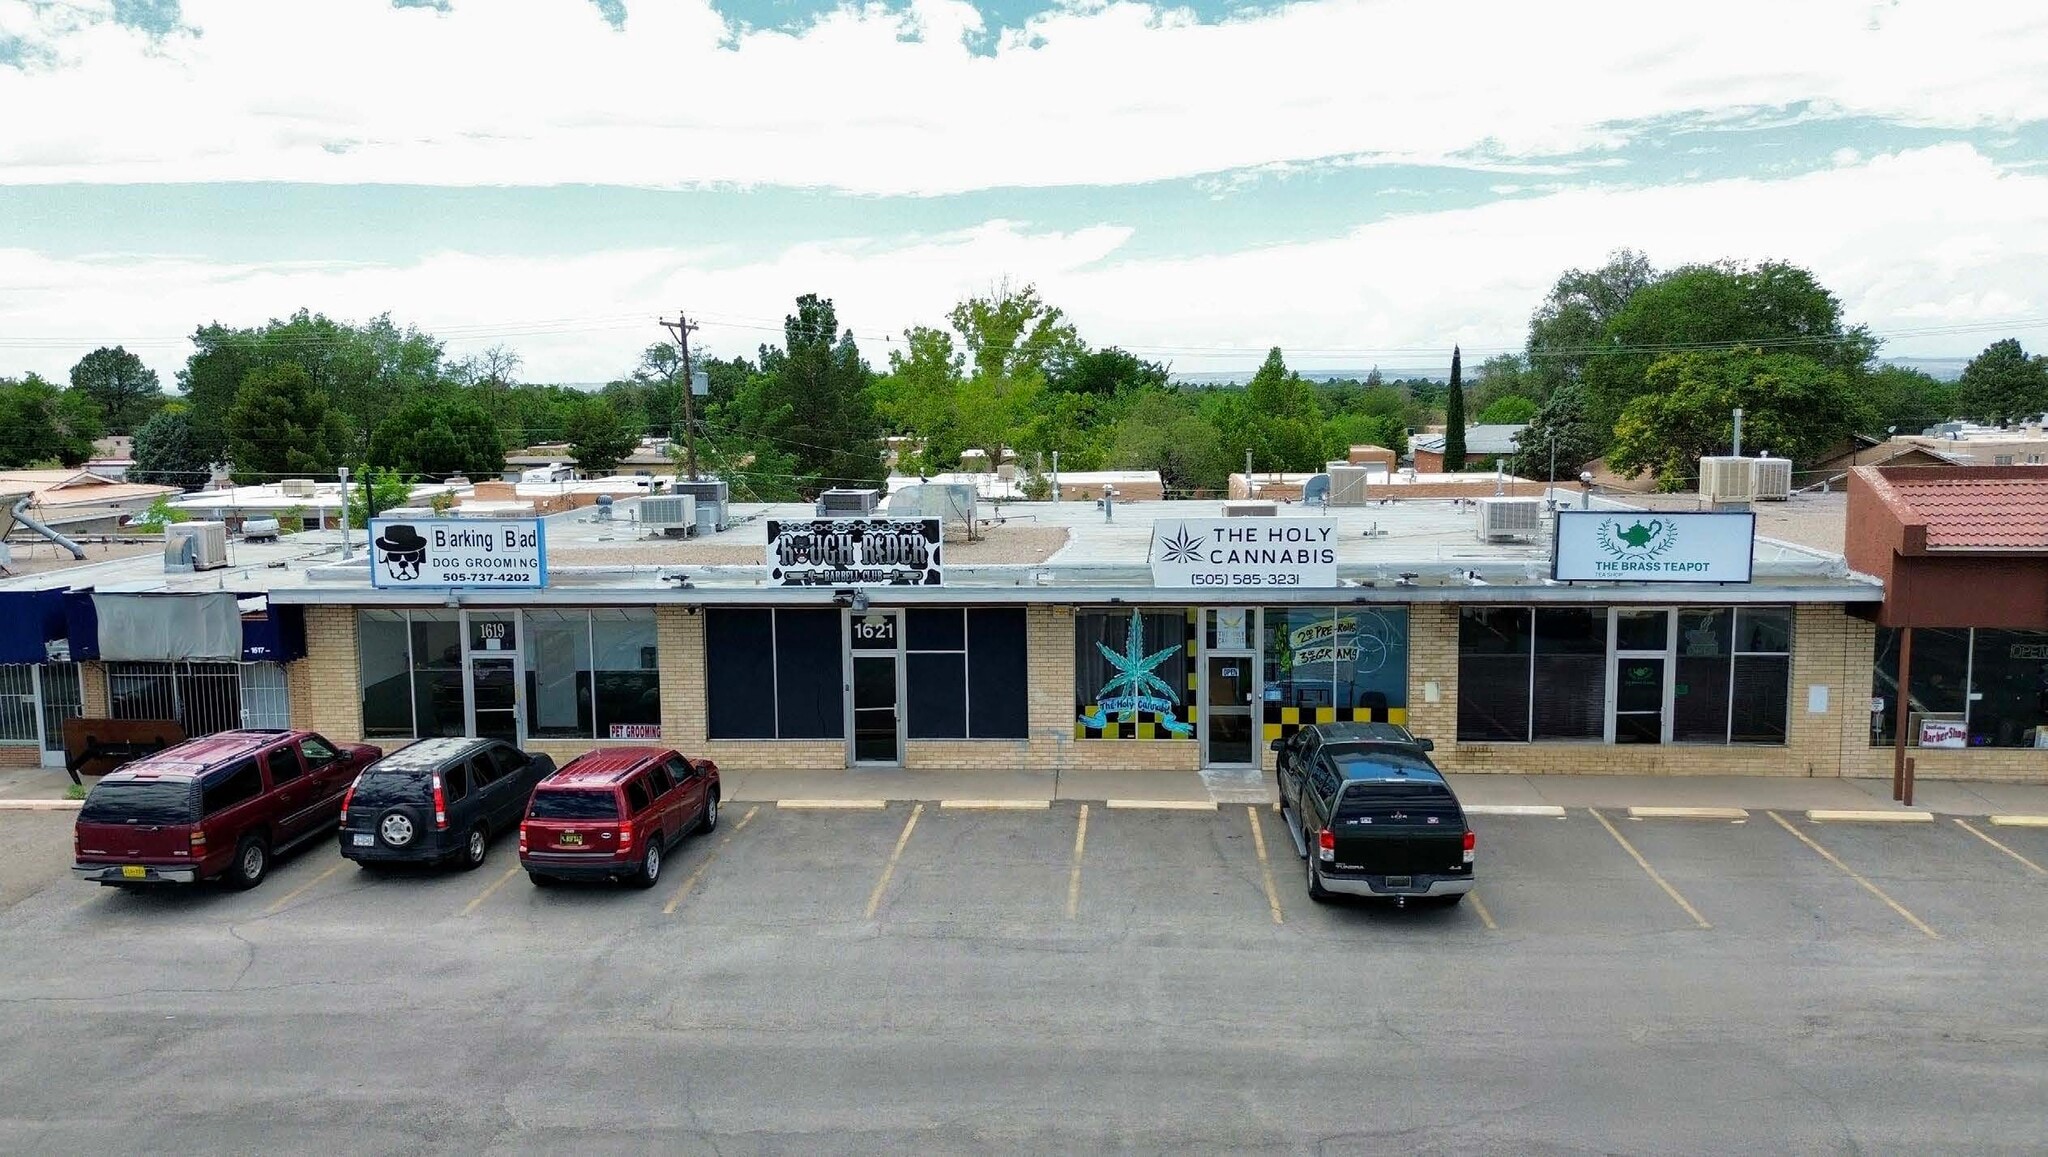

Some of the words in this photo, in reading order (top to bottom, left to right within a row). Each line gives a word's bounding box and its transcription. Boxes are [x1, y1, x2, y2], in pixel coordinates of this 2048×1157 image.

[435, 529, 493, 552] Barking
[505, 529, 537, 548] Bad
[1213, 527, 1258, 543] THE
[1268, 527, 1331, 543] HOLY
[433, 558, 460, 568] DOG
[465, 558, 538, 568] GROOMING
[1210, 549, 1334, 564] CANNABIS
[1595, 561, 1619, 571] THE
[1621, 561, 1661, 571] BRASS
[1663, 562, 1710, 572] TEAPOT
[443, 573, 530, 582] 505-737-4202
[823, 570, 860, 583] BARBELL
[862, 570, 884, 583] CLUB
[1191, 573, 1229, 586] (505)
[1232, 573, 1300, 585] 585-3231
[480, 623, 505, 638] 1619
[854, 623, 894, 639] 1621
[1223, 668, 1238, 676] OPEN
[611, 725, 624, 738] PET
[626, 725, 661, 738] GROOMING
